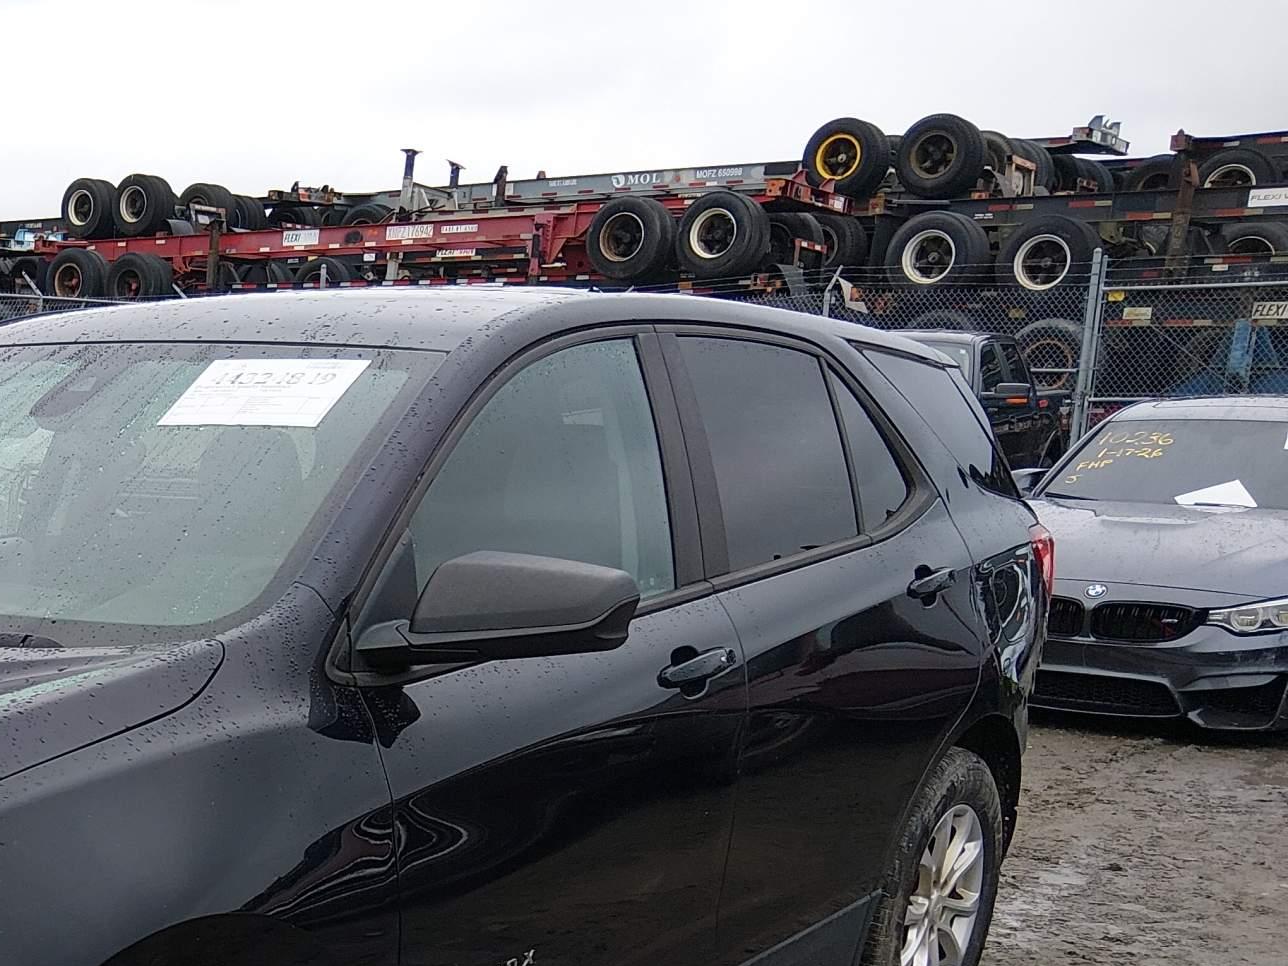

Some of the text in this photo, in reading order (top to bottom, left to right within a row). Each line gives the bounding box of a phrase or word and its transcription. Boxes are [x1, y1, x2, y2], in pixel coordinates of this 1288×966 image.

[627, 173, 661, 185] MOL
[1251, 193, 1282, 202] FLEXI
[283, 232, 302, 243] FLEXI
[1253, 303, 1288, 317] FLEXI
[1076, 458, 1113, 472] FHP
